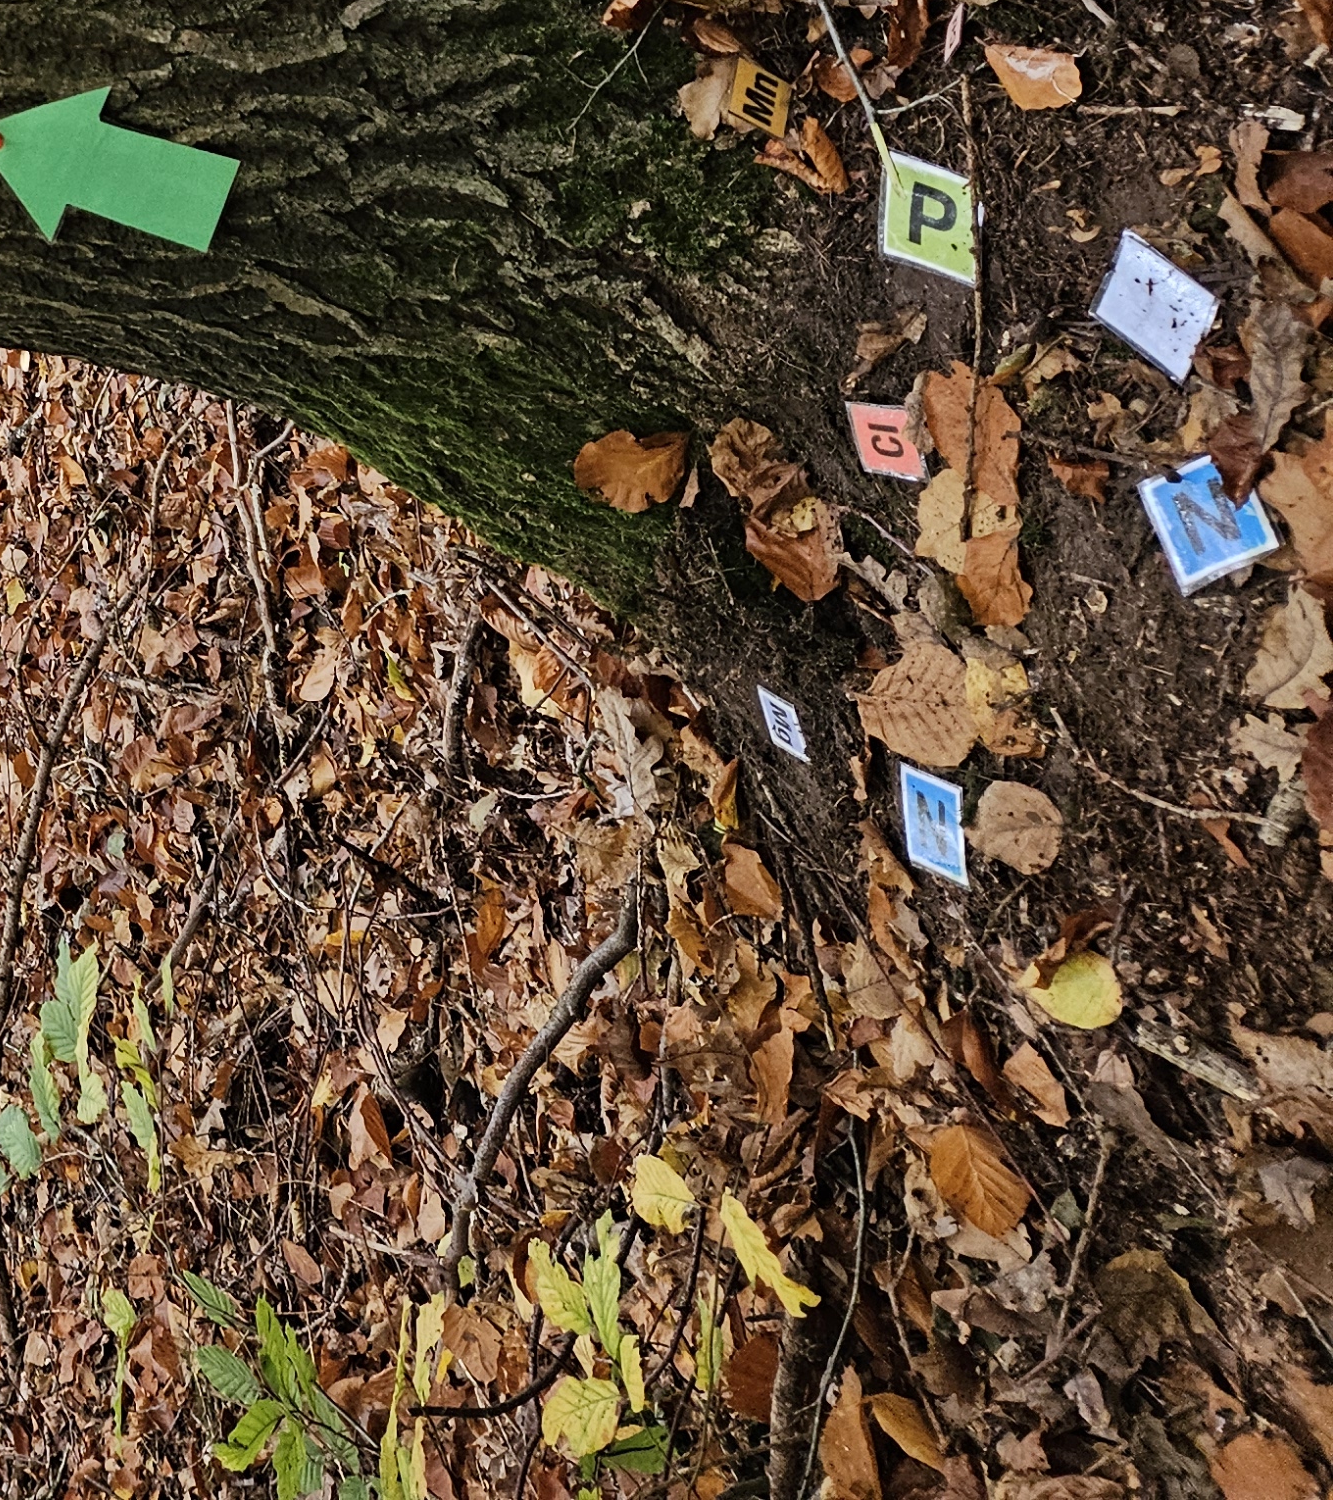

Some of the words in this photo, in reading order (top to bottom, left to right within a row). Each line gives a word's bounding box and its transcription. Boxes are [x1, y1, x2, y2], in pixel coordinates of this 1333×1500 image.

[742, 71, 779, 127] Mn
[908, 181, 957, 244] P
[867, 422, 905, 458] Cl
[1171, 476, 1242, 556] N
[769, 700, 793, 747] Mg
